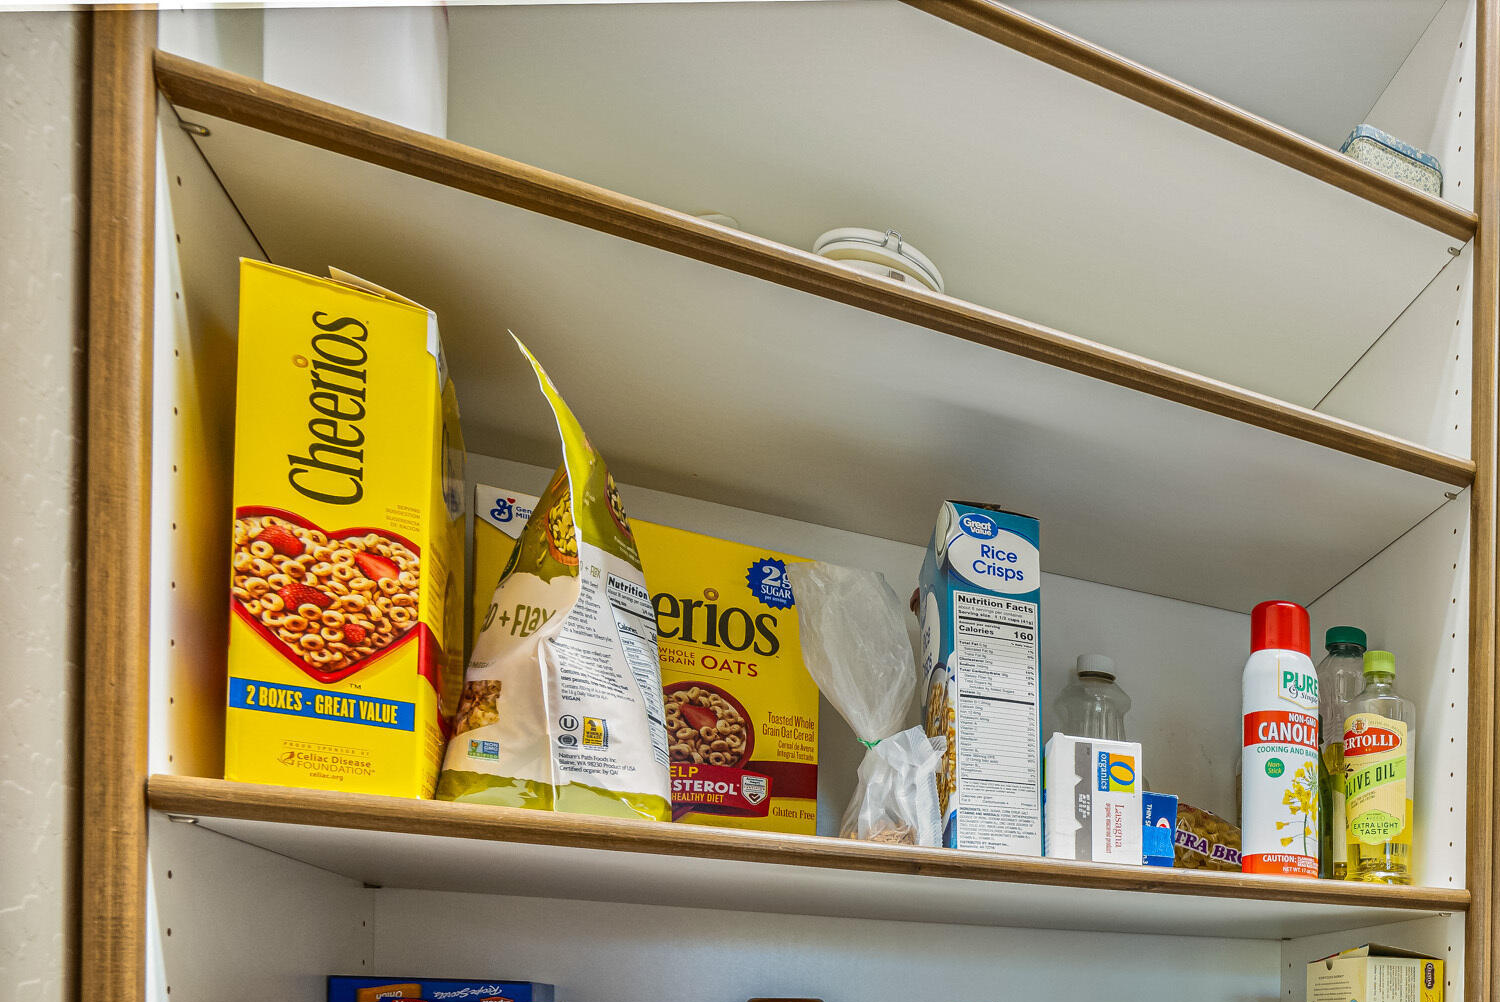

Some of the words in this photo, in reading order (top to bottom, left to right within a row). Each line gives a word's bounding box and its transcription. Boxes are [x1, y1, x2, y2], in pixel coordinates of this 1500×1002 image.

[288, 310, 369, 506] Cheerios
[963, 517, 992, 531] Great
[970, 526, 992, 537] Value
[980, 543, 1018, 564] Rice
[972, 559, 1025, 582] Crisps
[607, 575, 648, 601] Nutrition
[760, 584, 792, 600] SUGAR
[958, 594, 1003, 609] Nutrition
[1006, 602, 1034, 614] Facts
[652, 587, 780, 658] erios
[958, 625, 995, 636] Calories
[1013, 630, 1034, 641] 160
[658, 645, 695, 659] WHOLE
[659, 654, 695, 667] GRAIN
[700, 655, 759, 678] OATS
[1282, 671, 1319, 695] PURE
[246, 685, 256, 704] 2
[258, 687, 303, 711] BOXES
[314, 694, 357, 719] GREAT
[359, 701, 398, 724] VALUE
[767, 711, 793, 729] Toasted
[793, 715, 815, 730] Whole
[1288, 712, 1317, 728] NON-GMO
[762, 723, 780, 737] Grain
[780, 726, 792, 739] Oat
[792, 728, 815, 743] Cereal
[1258, 721, 1317, 747] CANOLA
[1257, 745, 1289, 754] COOKING
[1289, 746, 1305, 756] AND
[296, 752, 328, 764] Celiac
[331, 756, 371, 768] Disease
[297, 760, 371, 776] FOUNDATION
[1098, 753, 1108, 791] organics
[1375, 763, 1396, 781] OIL
[671, 792, 705, 802] HEALTHY
[706, 793, 725, 803] DIET
[772, 806, 797, 819] Gluten
[799, 810, 815, 822] Free
[1113, 803, 1125, 848] Lasagna
[1353, 822, 1378, 830] EXTRA
[1378, 822, 1399, 830] LIGHT
[1262, 854, 1297, 863] CAUTION:
